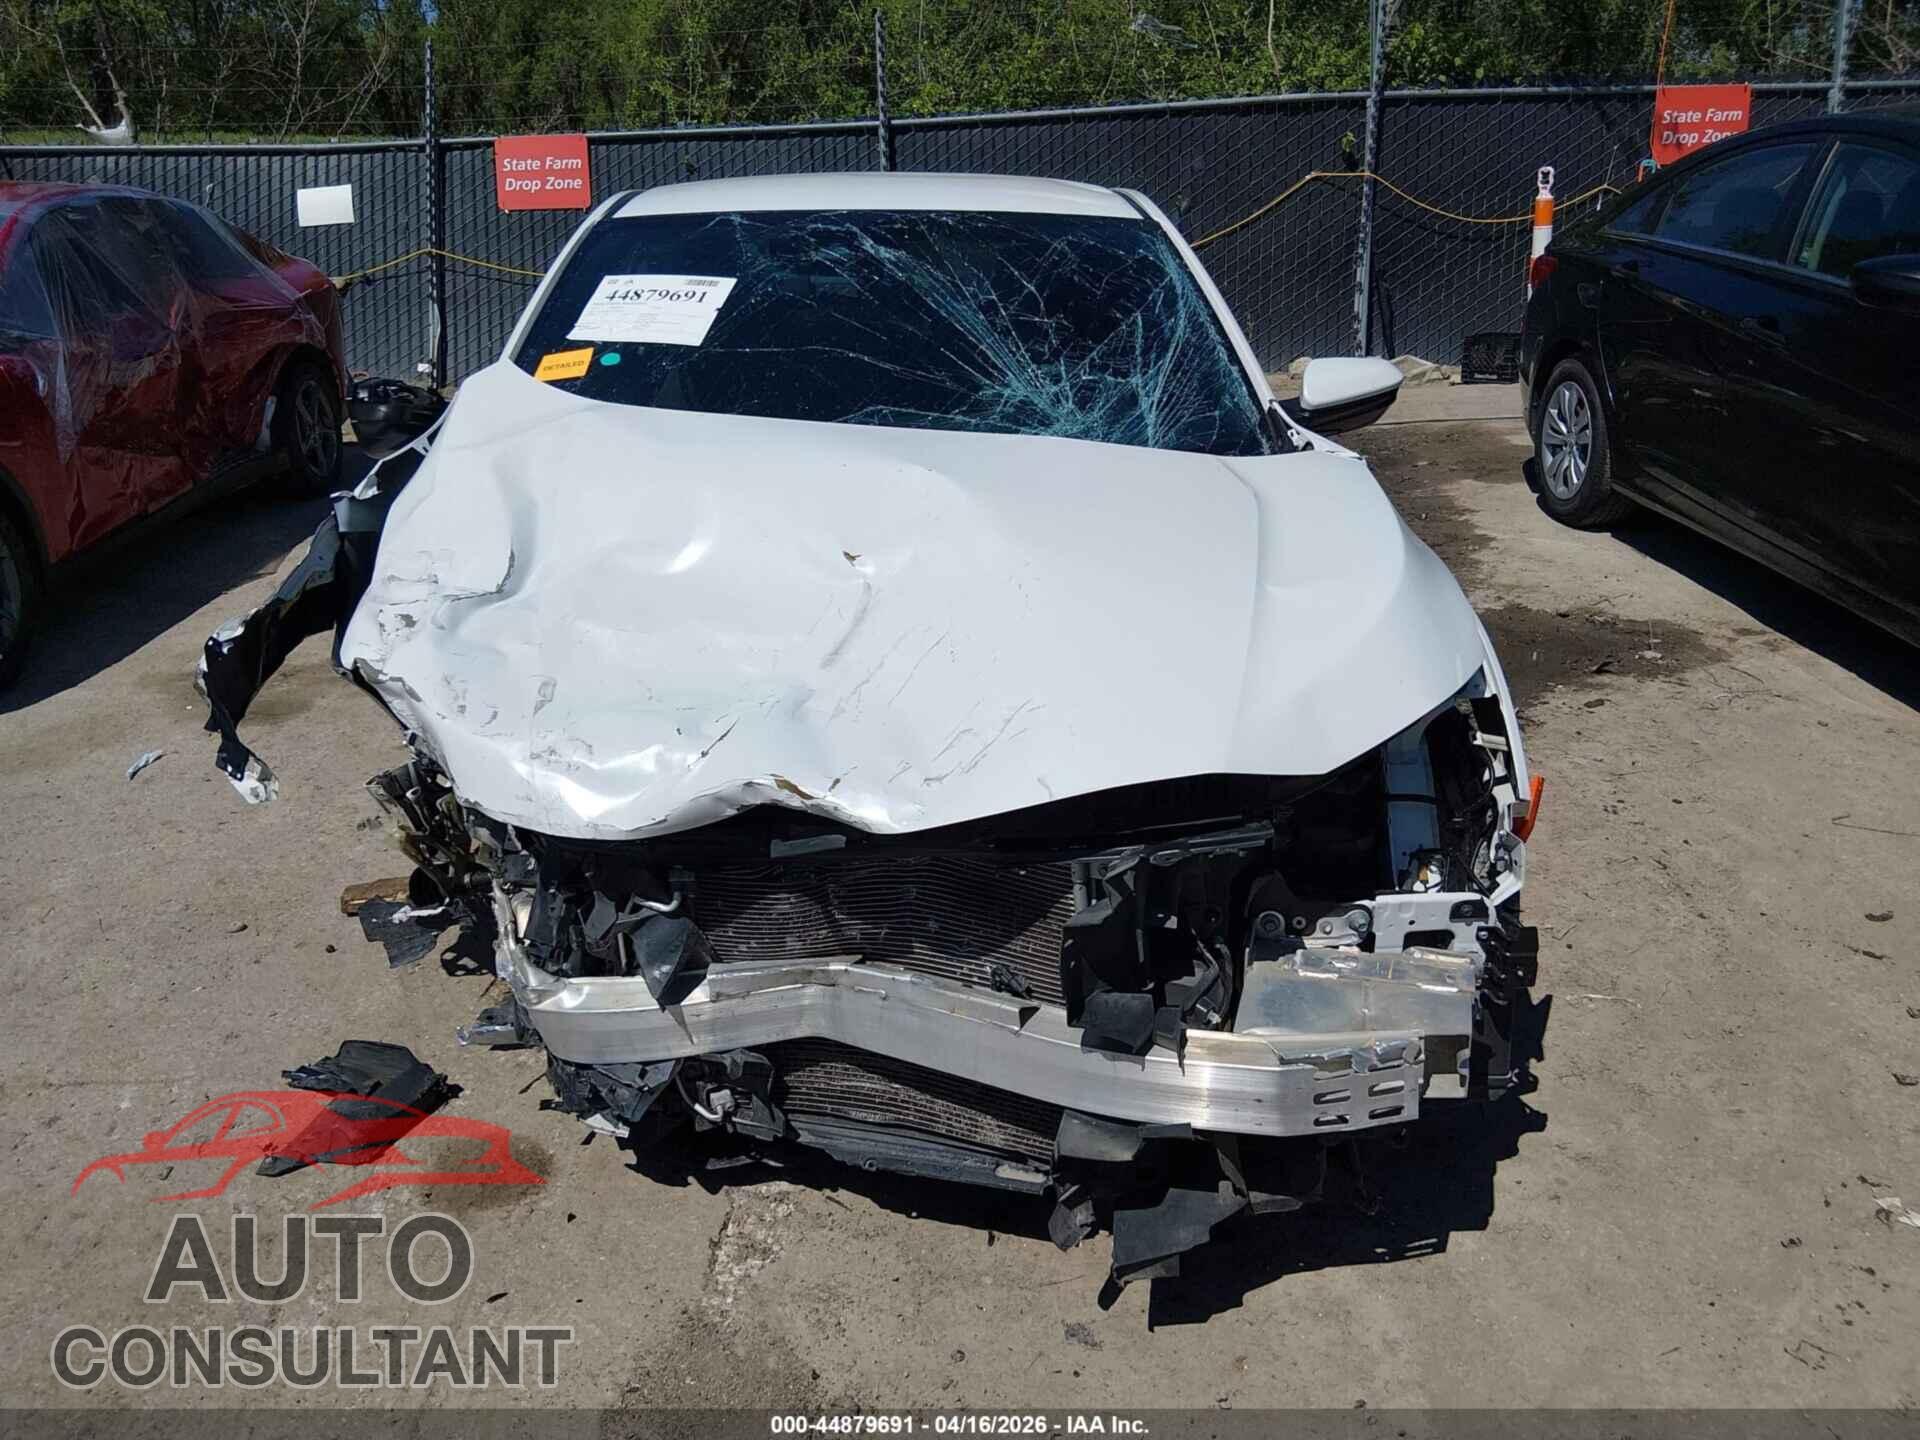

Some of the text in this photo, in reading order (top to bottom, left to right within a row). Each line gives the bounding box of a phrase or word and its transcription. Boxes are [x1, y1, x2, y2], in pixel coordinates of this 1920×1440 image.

[1662, 108, 1742, 124] State Farm
[1662, 131, 1699, 147] Drop
[503, 156, 582, 172] State Farm
[505, 176, 582, 193] Drop Zone
[605, 288, 707, 303] 44879691
